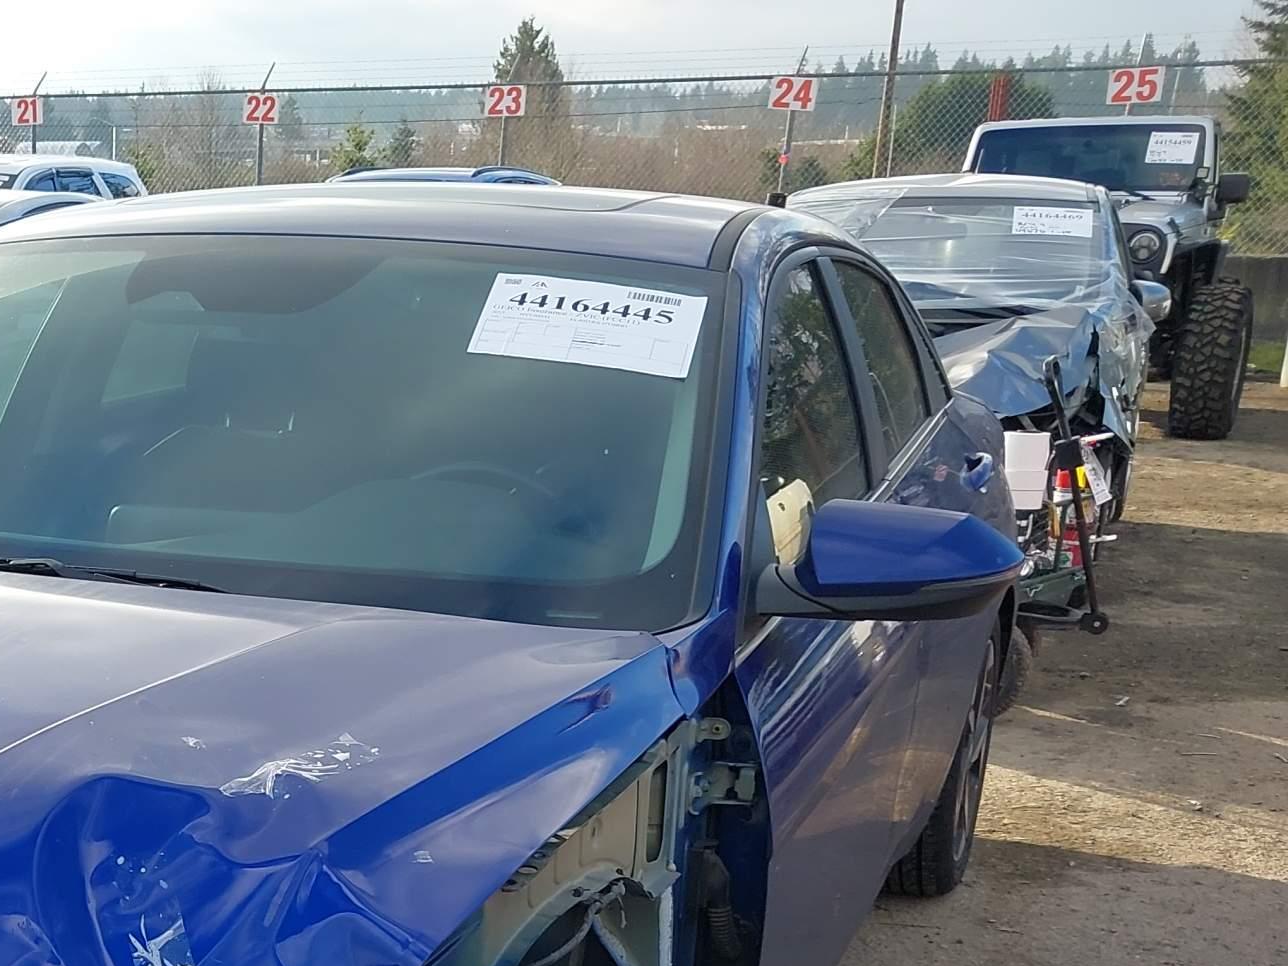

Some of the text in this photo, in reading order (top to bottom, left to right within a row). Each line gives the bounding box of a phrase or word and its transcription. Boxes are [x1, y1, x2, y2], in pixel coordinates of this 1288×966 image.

[773, 79, 813, 109] 24
[1111, 68, 1159, 103] 25
[16, 99, 38, 124] 21
[247, 95, 276, 122] 22
[488, 86, 522, 116] 23
[509, 291, 675, 325] 44164445
